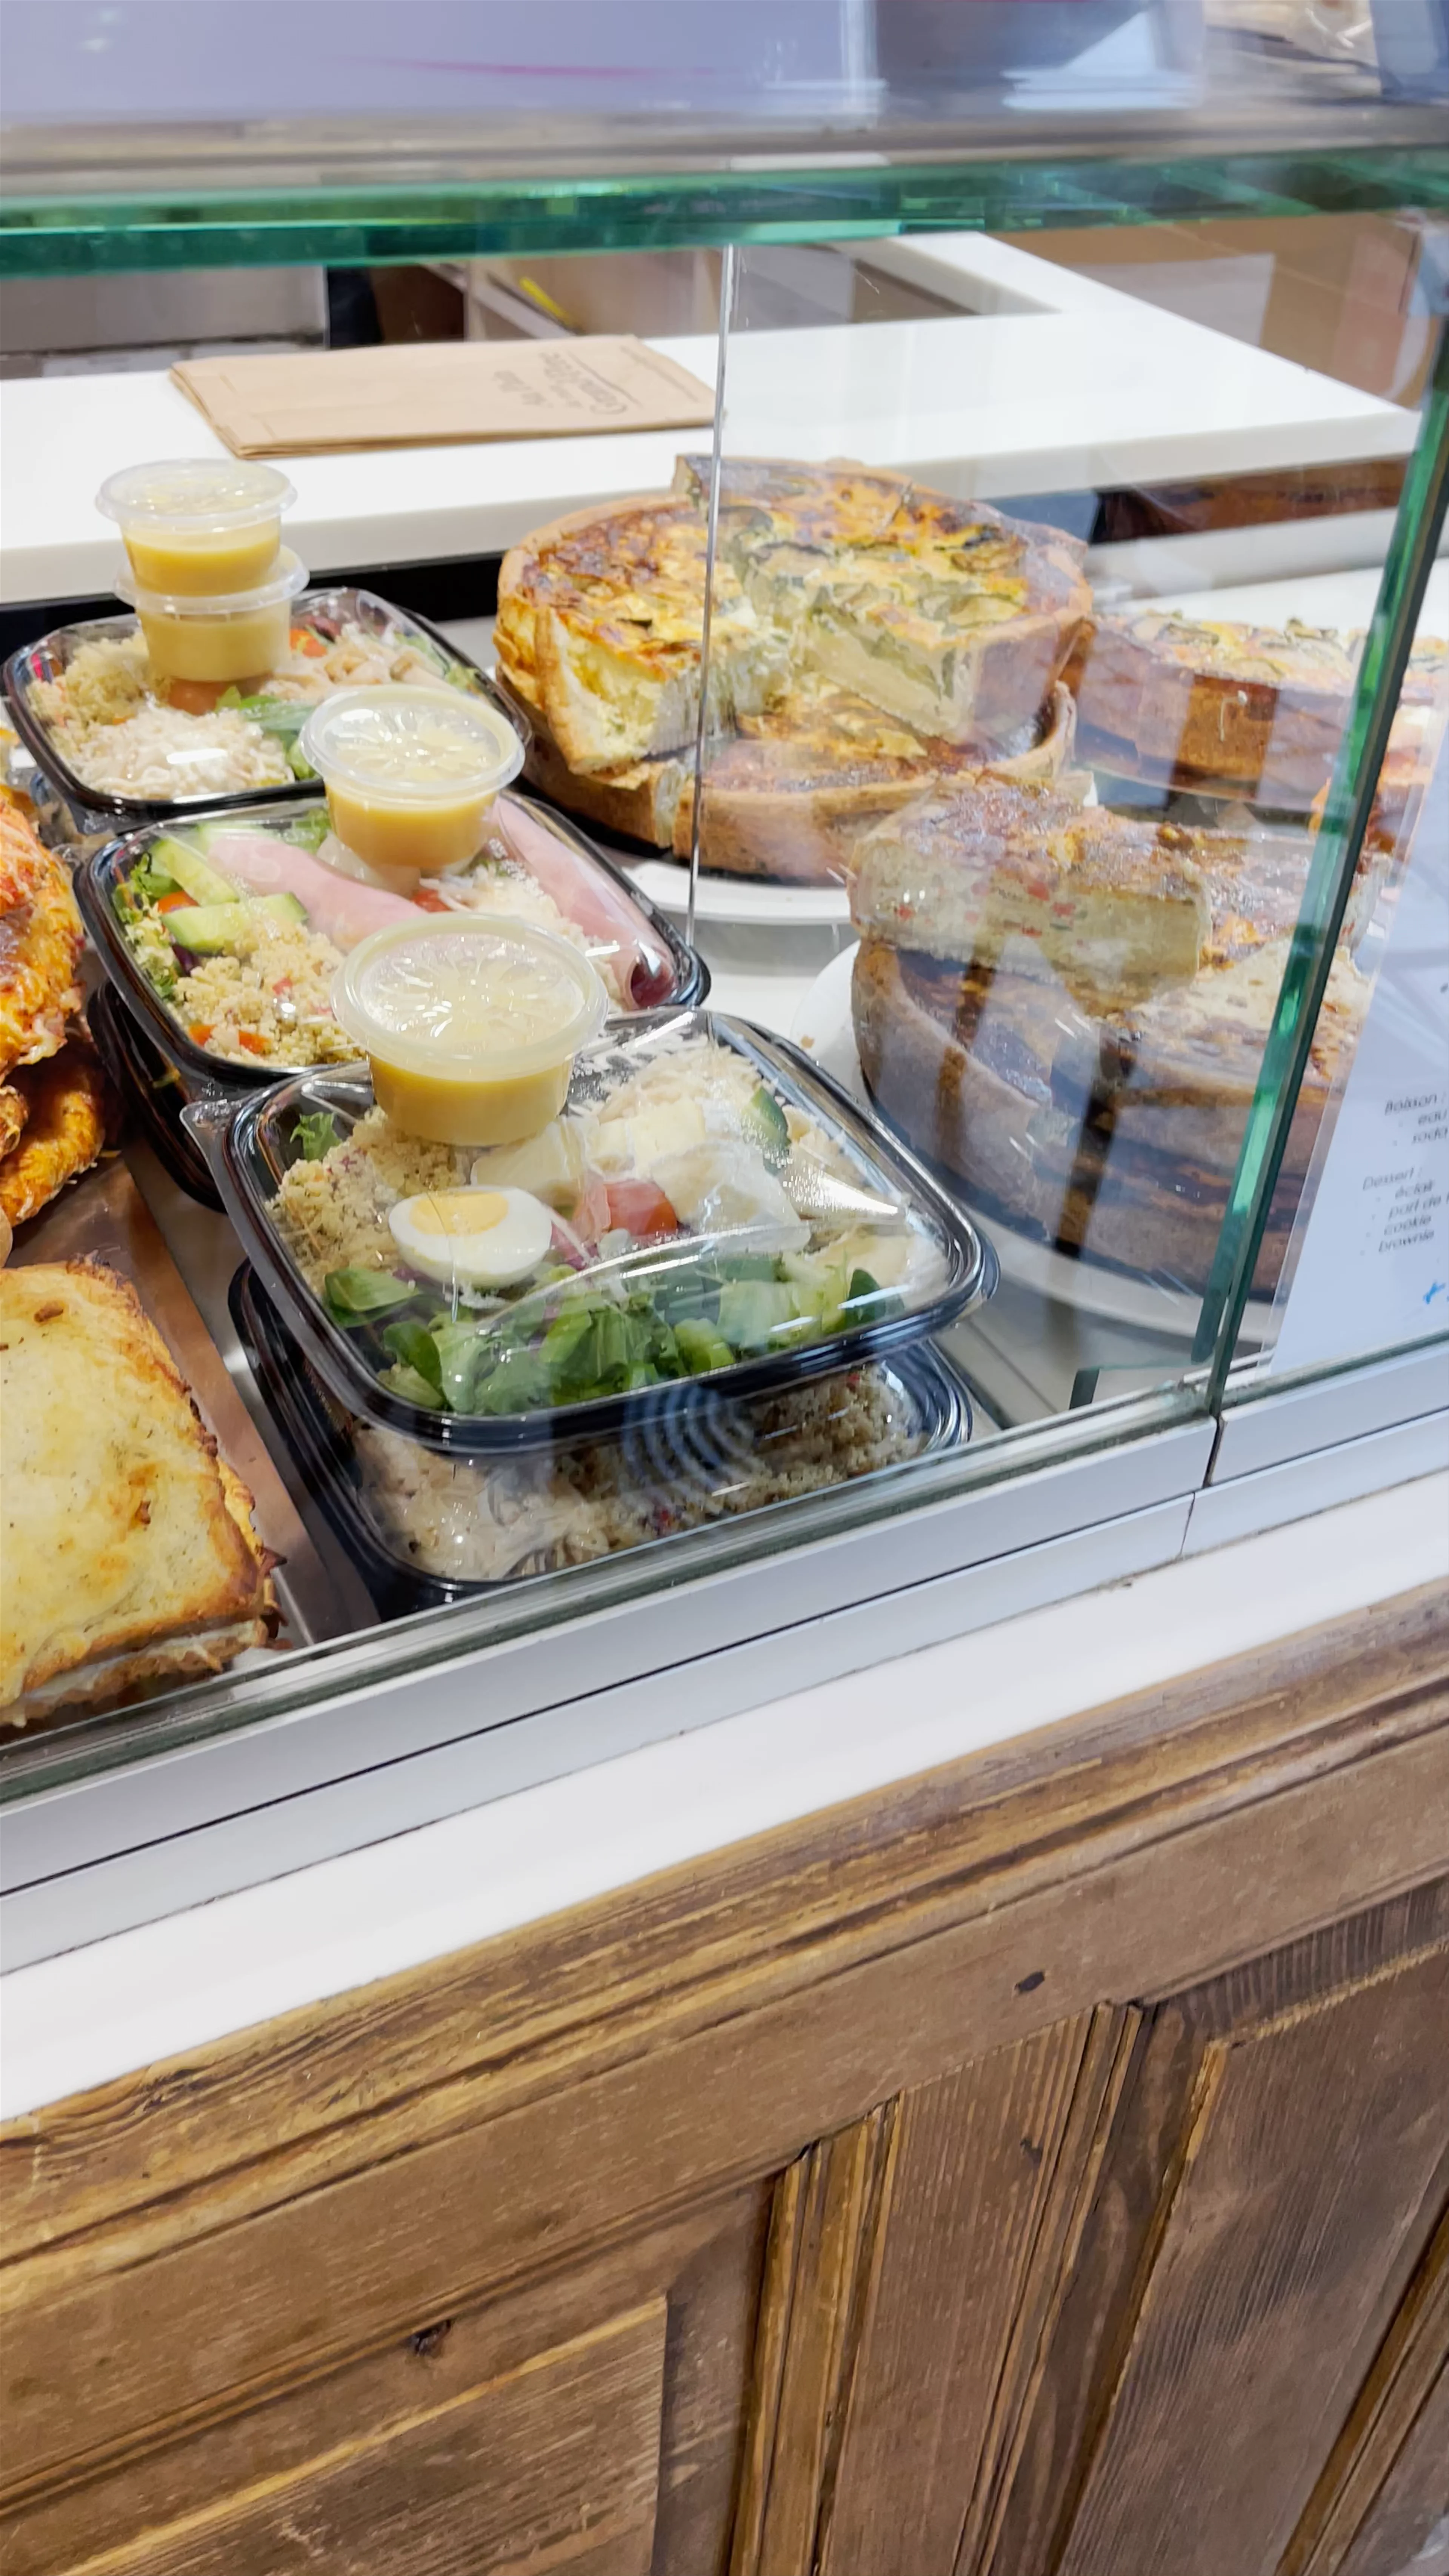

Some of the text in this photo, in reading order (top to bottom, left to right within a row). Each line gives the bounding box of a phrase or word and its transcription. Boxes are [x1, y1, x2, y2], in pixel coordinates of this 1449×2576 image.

[1363, 1167, 1414, 1191] Dessert
[1383, 1214, 1432, 1236] cookie
[1378, 1229, 1435, 1253] brownie
